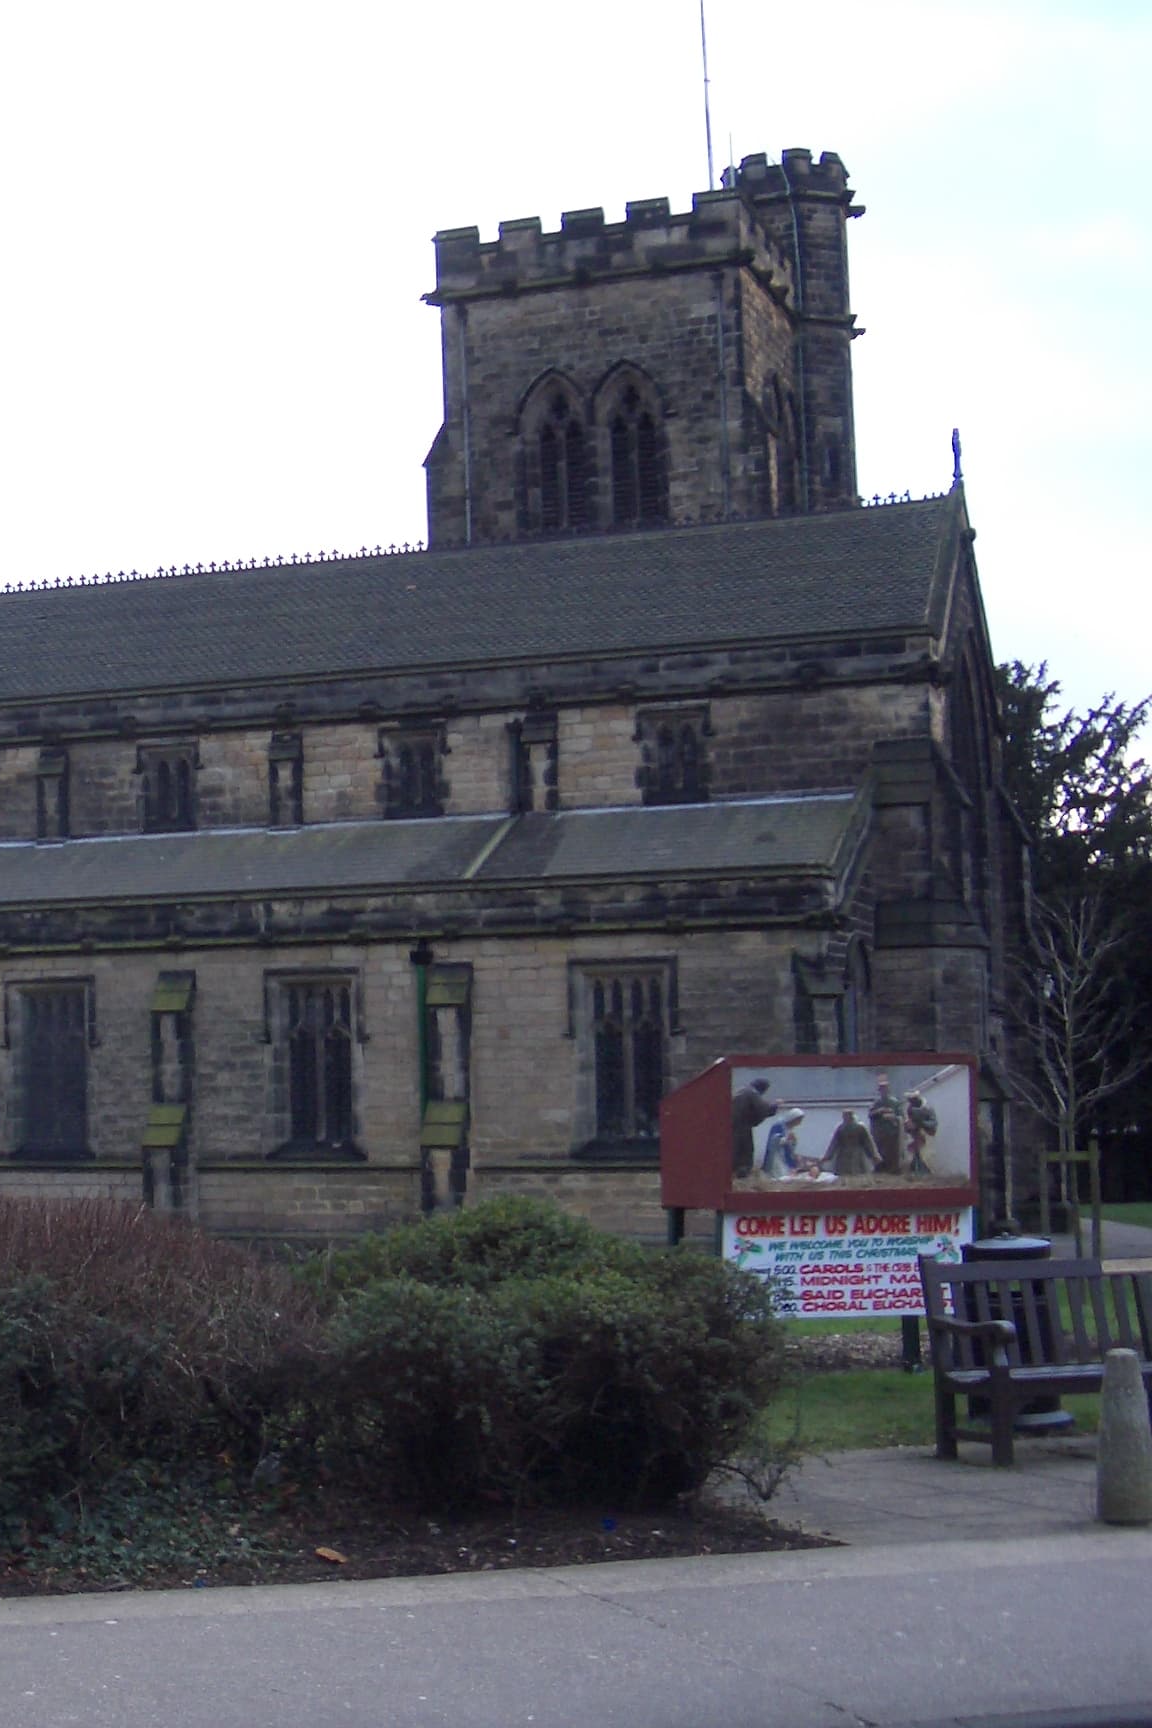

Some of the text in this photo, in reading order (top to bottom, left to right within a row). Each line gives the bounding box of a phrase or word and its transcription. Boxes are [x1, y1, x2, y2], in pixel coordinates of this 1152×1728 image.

[735, 1214, 960, 1236] COME LET US ADORE HIM!
[768, 1235, 935, 1252] WE WELCOME YOU TO WORSHIP
[775, 1246, 918, 1262] WITH US THIS CHRISTMAS
[800, 1264, 864, 1275] CAROLS
[801, 1275, 882, 1286] MIDNIGHT
[890, 1273, 921, 1284] MA
[800, 1290, 845, 1301] SAID
[802, 1301, 868, 1313] CHORAL
